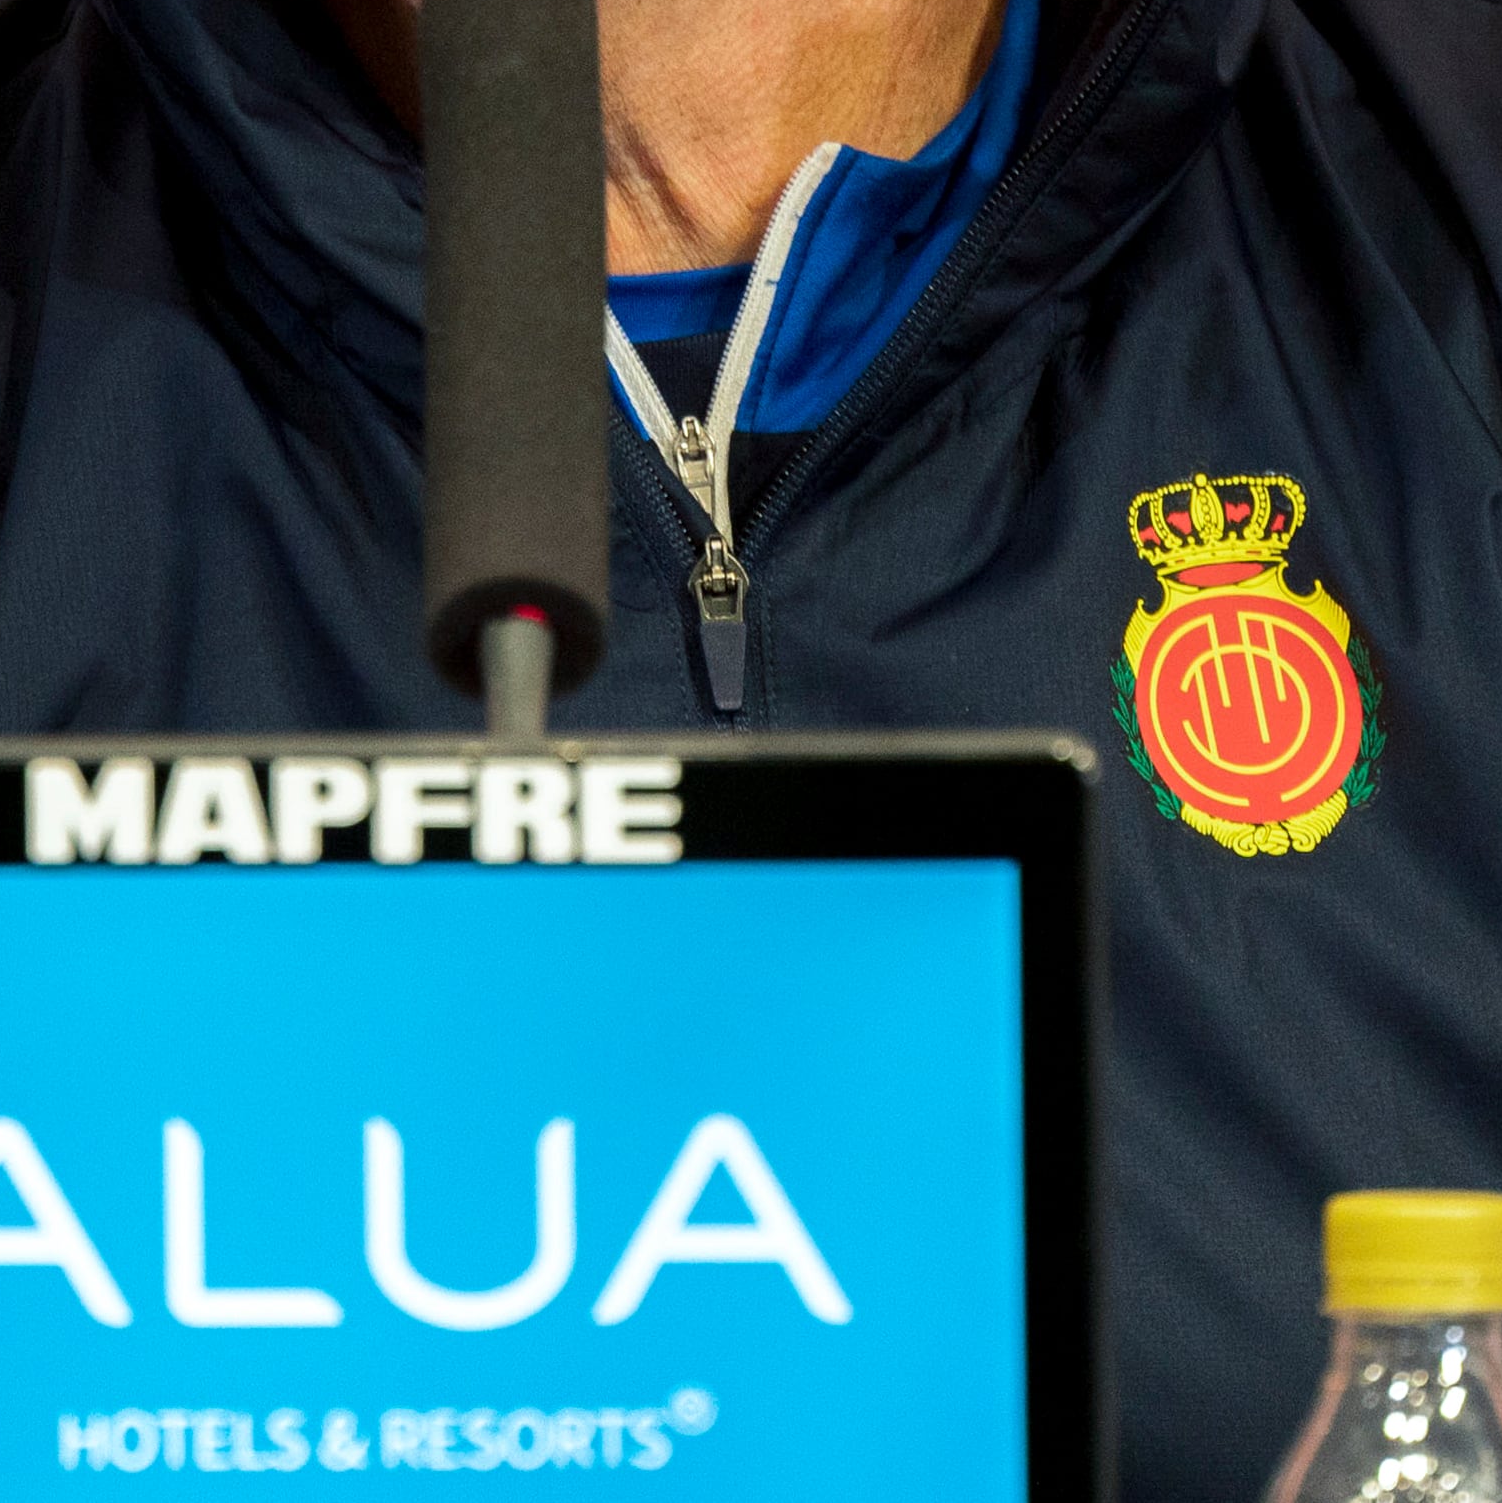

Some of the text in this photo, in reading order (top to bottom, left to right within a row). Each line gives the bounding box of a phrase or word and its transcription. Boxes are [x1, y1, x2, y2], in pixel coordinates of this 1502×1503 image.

[24, 756, 685, 865] MAPFRE
[57, 1407, 310, 1472] HOTELS
[317, 1408, 369, 1472] &
